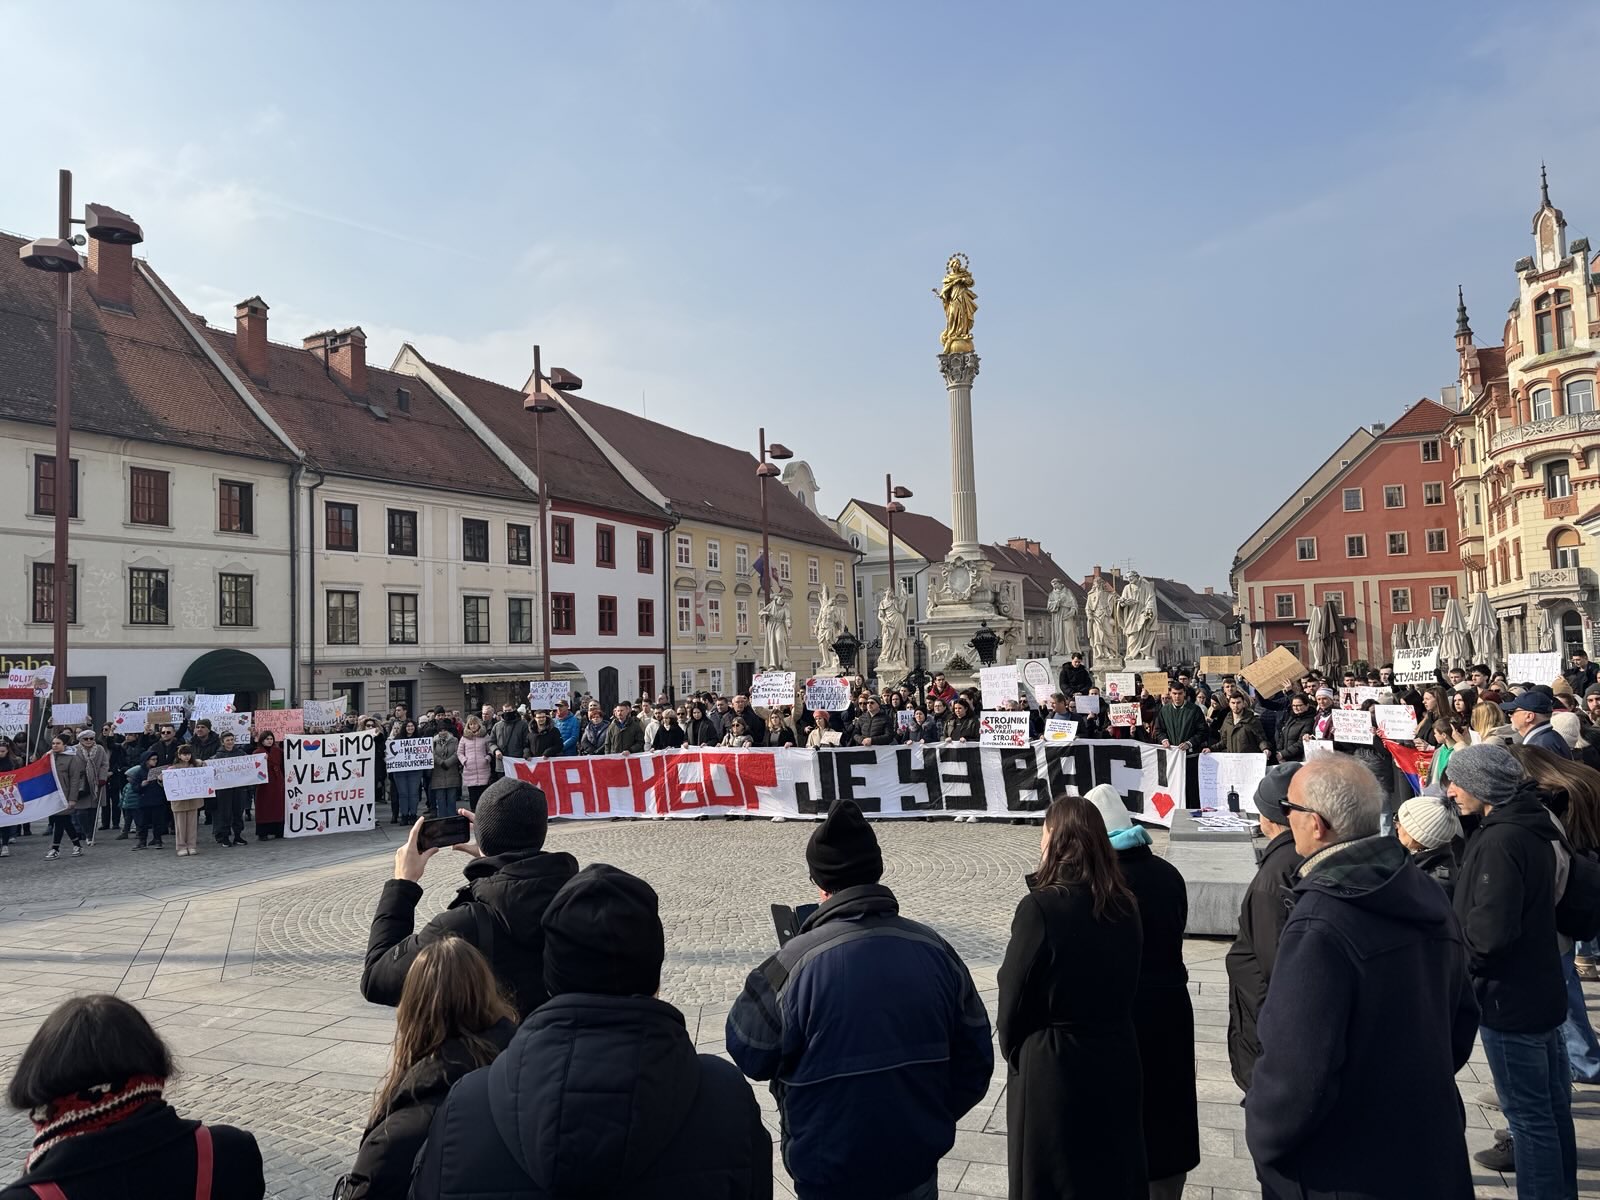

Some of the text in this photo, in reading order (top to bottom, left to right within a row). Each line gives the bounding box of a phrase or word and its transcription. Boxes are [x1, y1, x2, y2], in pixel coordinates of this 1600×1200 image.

[1397, 647, 1434, 659] МАРИБОР
[343, 665, 407, 677] EDIČAR SVEČAR
[1411, 660, 1421, 670] УЗ
[1394, 670, 1434, 682] СТУДЕНТЕ
[138, 697, 147, 706] НЕ
[984, 716, 1028, 724] STROJNIKI
[400, 739, 416, 747] HALO
[166, 771, 178, 779] ZA
[293, 758, 372, 785] VLAST
[513, 752, 778, 816] МАРИБОР
[795, 749, 881, 814] ЈЕ
[896, 746, 988, 811] УЗ
[1000, 744, 1168, 814] ВАС!
[287, 786, 365, 805] DA POŠTUJE
[289, 803, 373, 833] USTAV!
